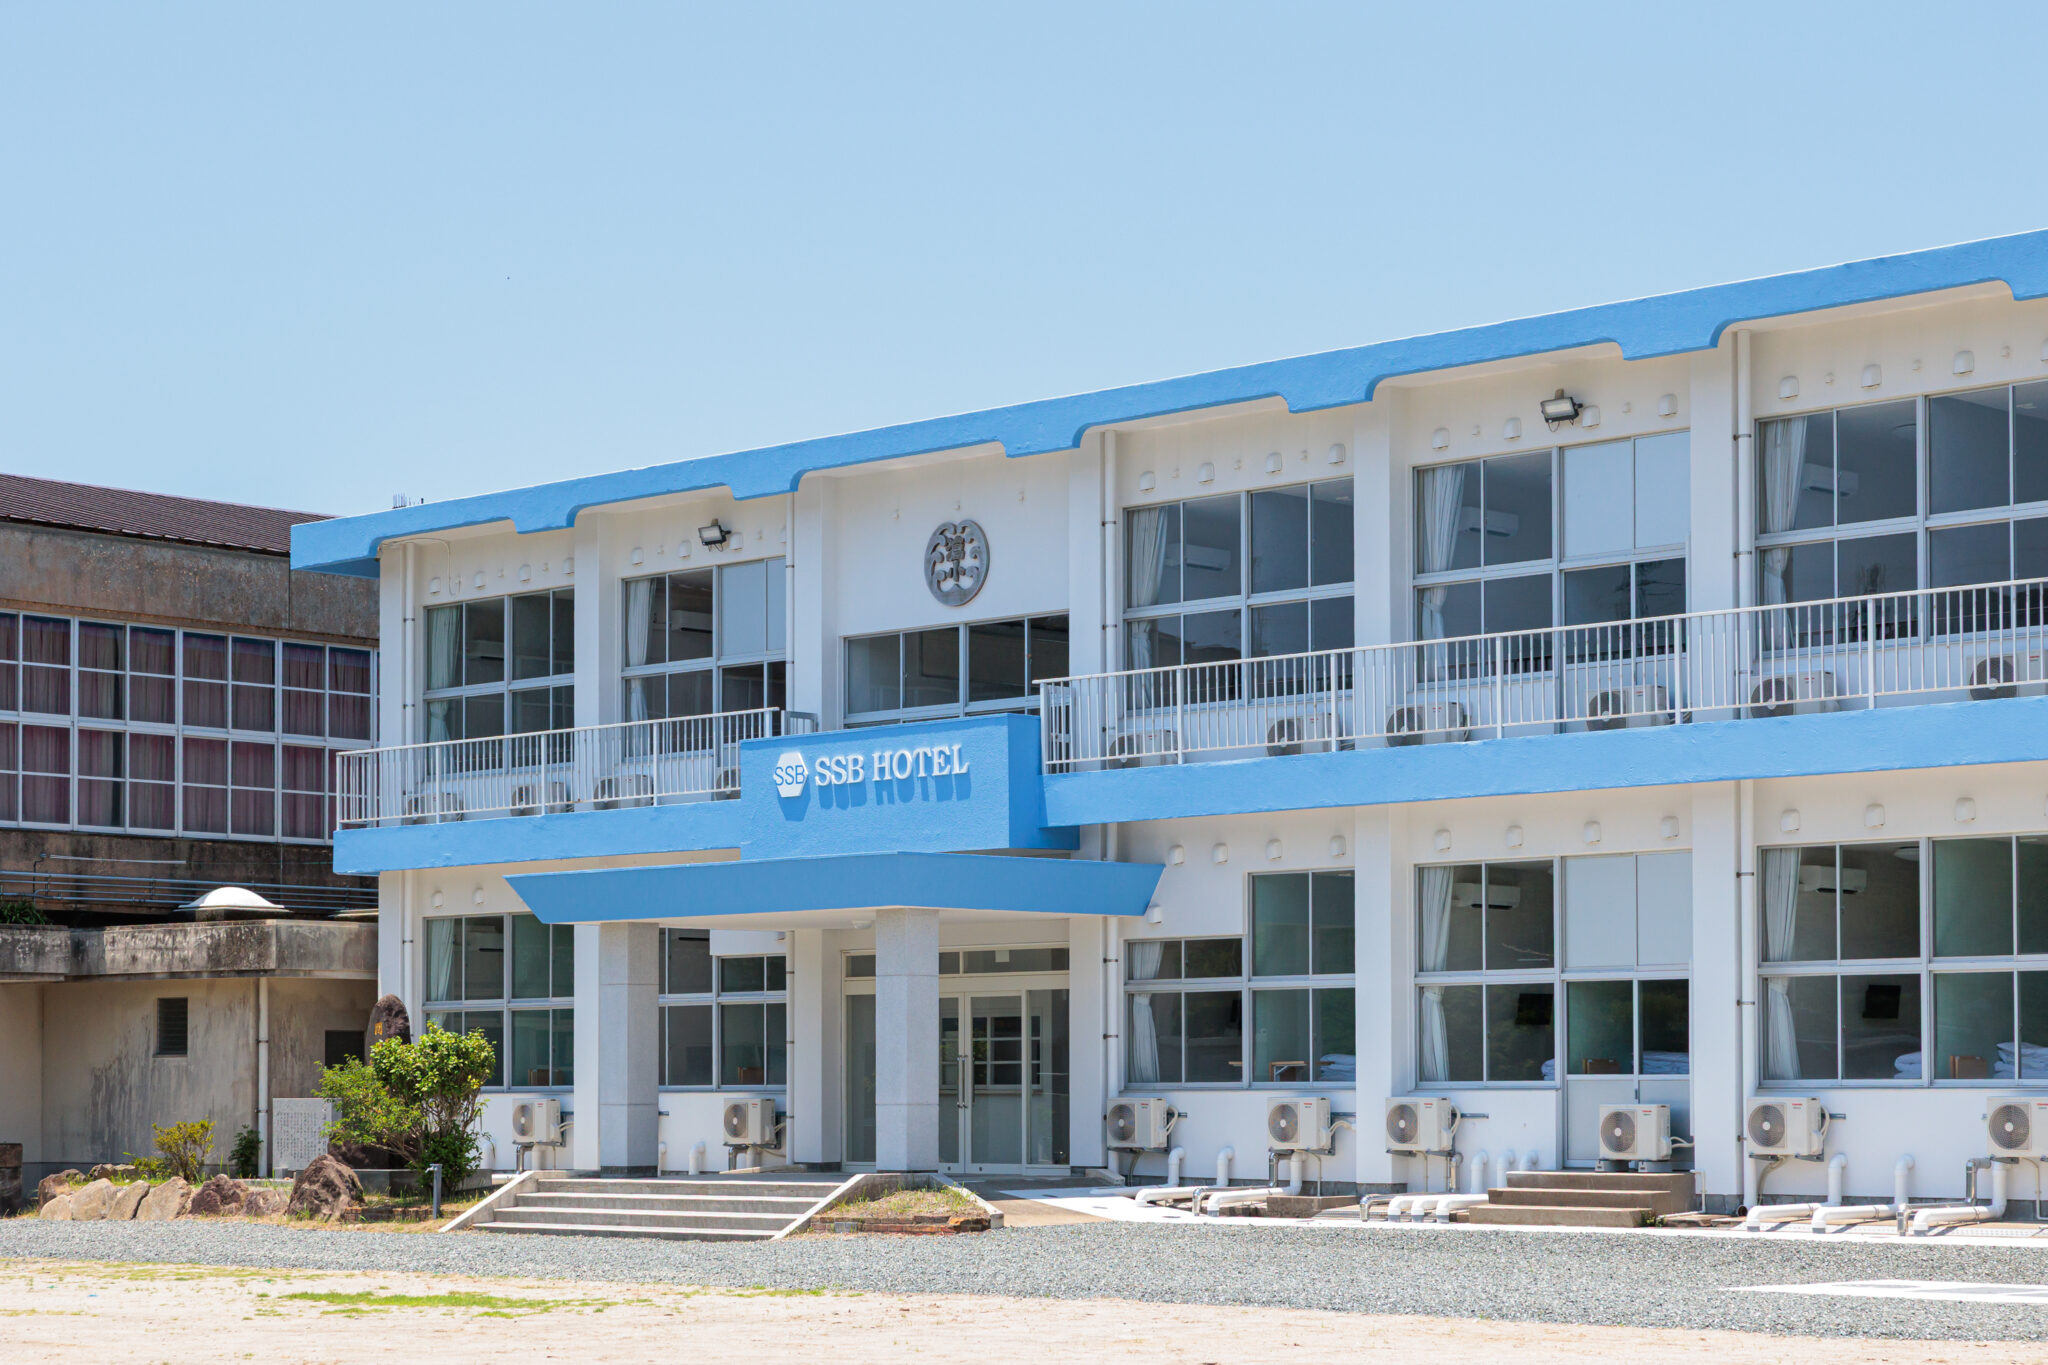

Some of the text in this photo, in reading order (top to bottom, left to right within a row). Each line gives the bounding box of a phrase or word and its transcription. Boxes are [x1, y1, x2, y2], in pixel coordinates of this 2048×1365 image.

[774, 764, 805, 786] SSB
[815, 744, 970, 787] SSB HOTEL
